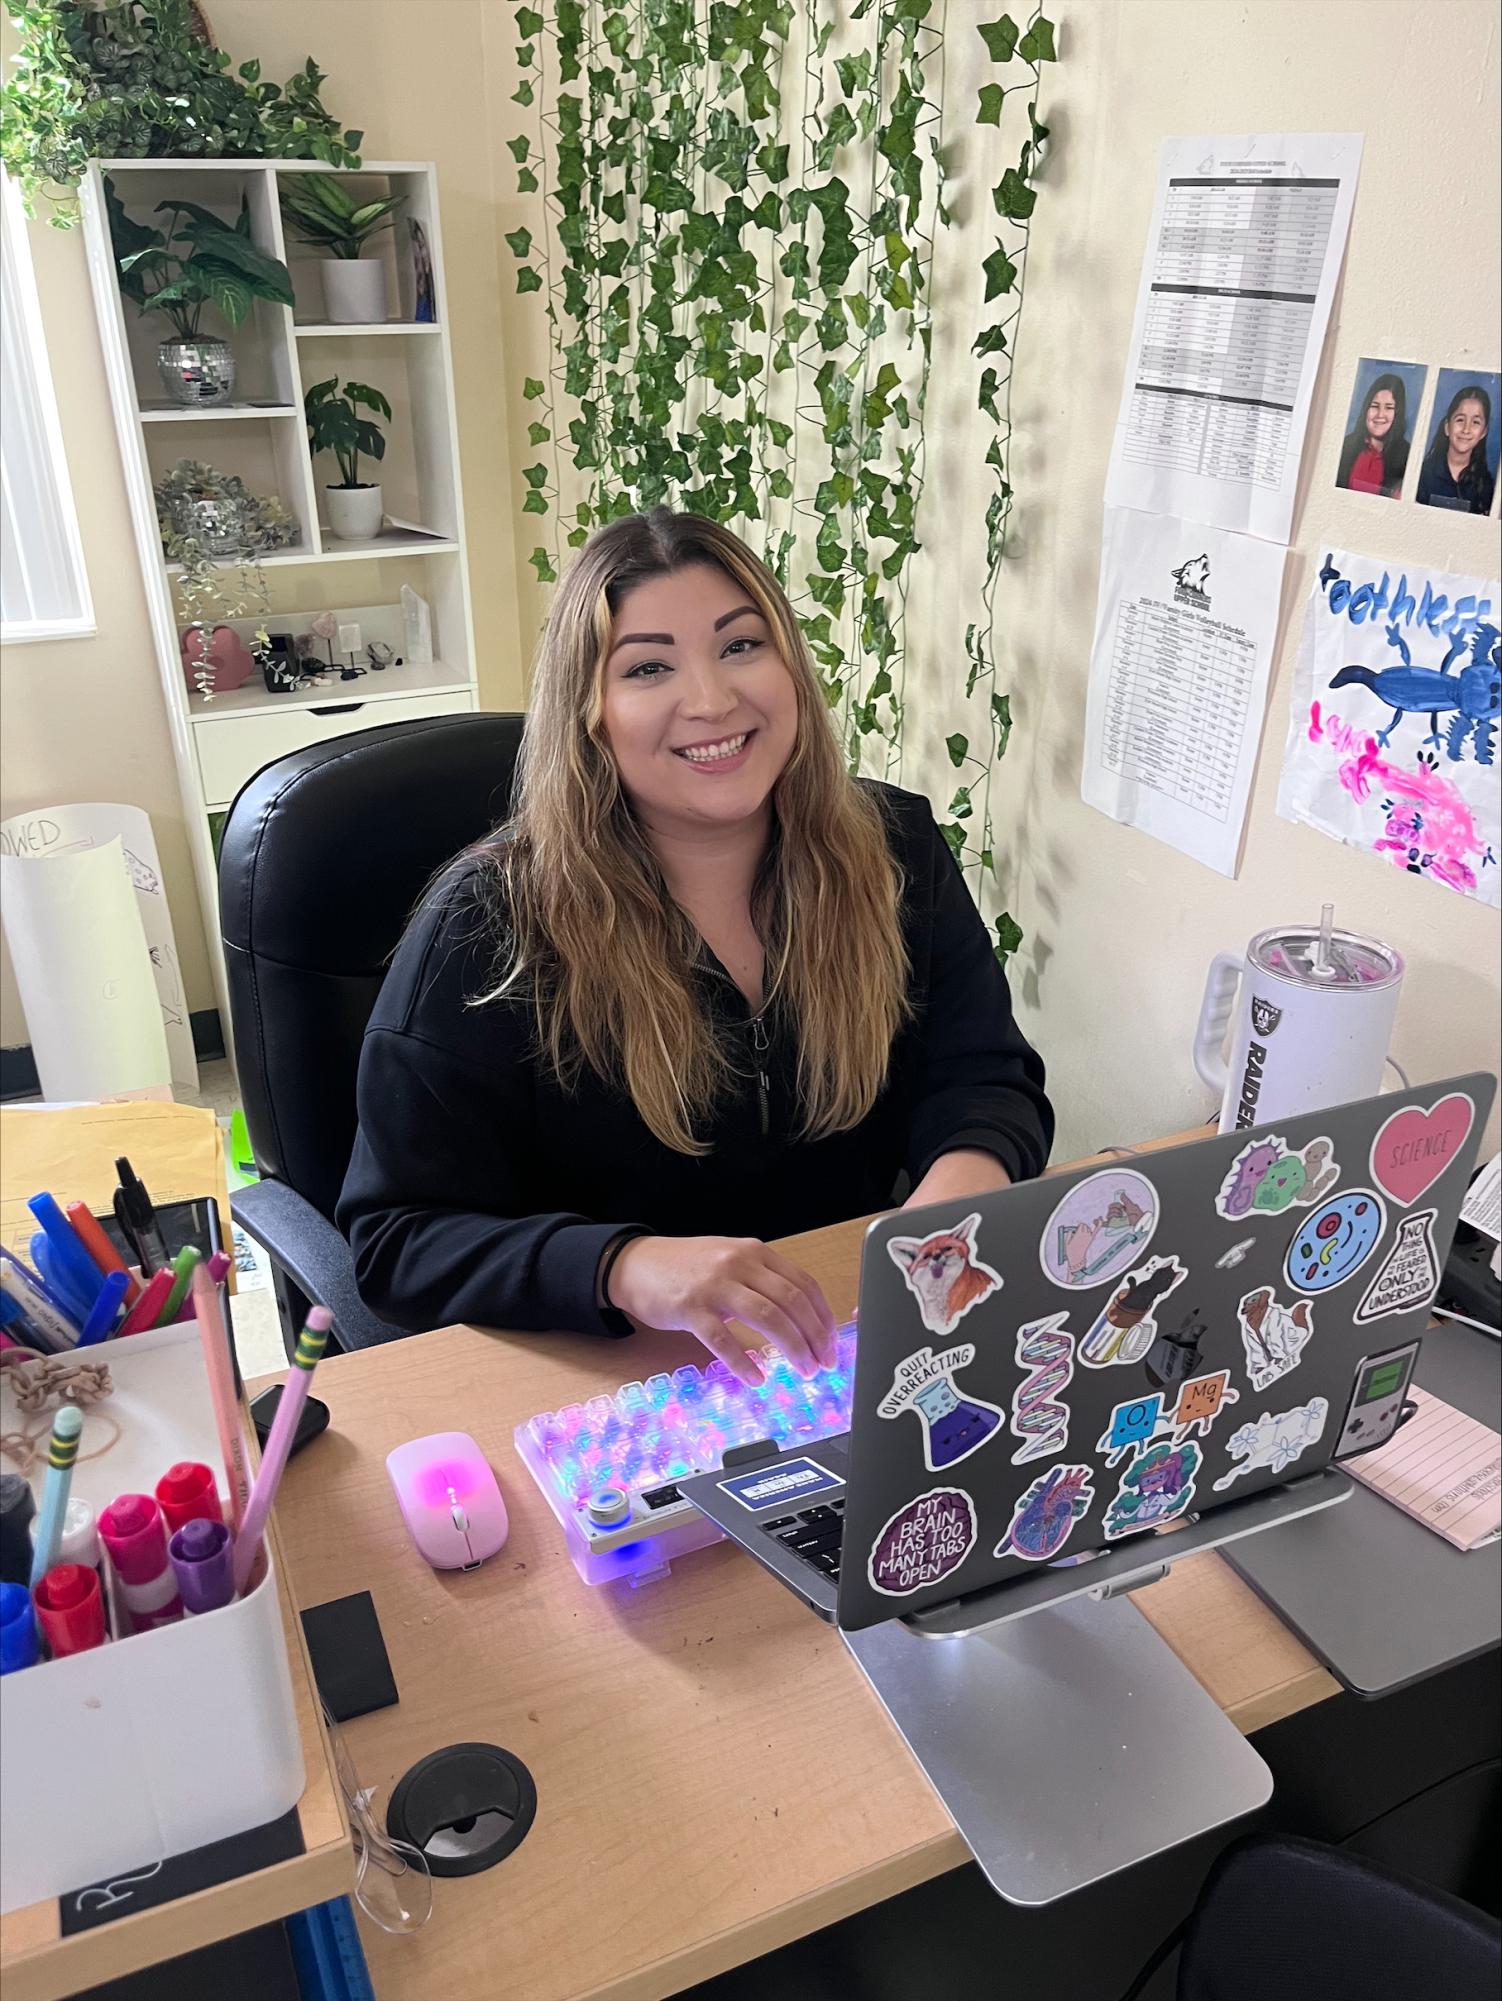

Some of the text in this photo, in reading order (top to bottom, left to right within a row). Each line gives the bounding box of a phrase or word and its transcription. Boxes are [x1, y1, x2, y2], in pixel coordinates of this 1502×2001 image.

[1390, 1129, 1451, 1169] SCIENCE
[1404, 1222, 1424, 1241] NO
[1378, 1266, 1421, 1292] ONLY
[1368, 1277, 1431, 1310] UNDERSTOOD
[900, 1351, 929, 1378] QUIT
[882, 1348, 971, 1415] OVERREACTING
[1192, 1382, 1217, 1401] Mg
[1127, 1404, 1146, 1426] O
[917, 1496, 943, 1518] MY
[900, 1508, 956, 1539] BRAIN
[890, 1522, 963, 1558] HAS TOO
[878, 1536, 966, 1578] MANY TABS
[899, 1559, 942, 1586] OPEN
